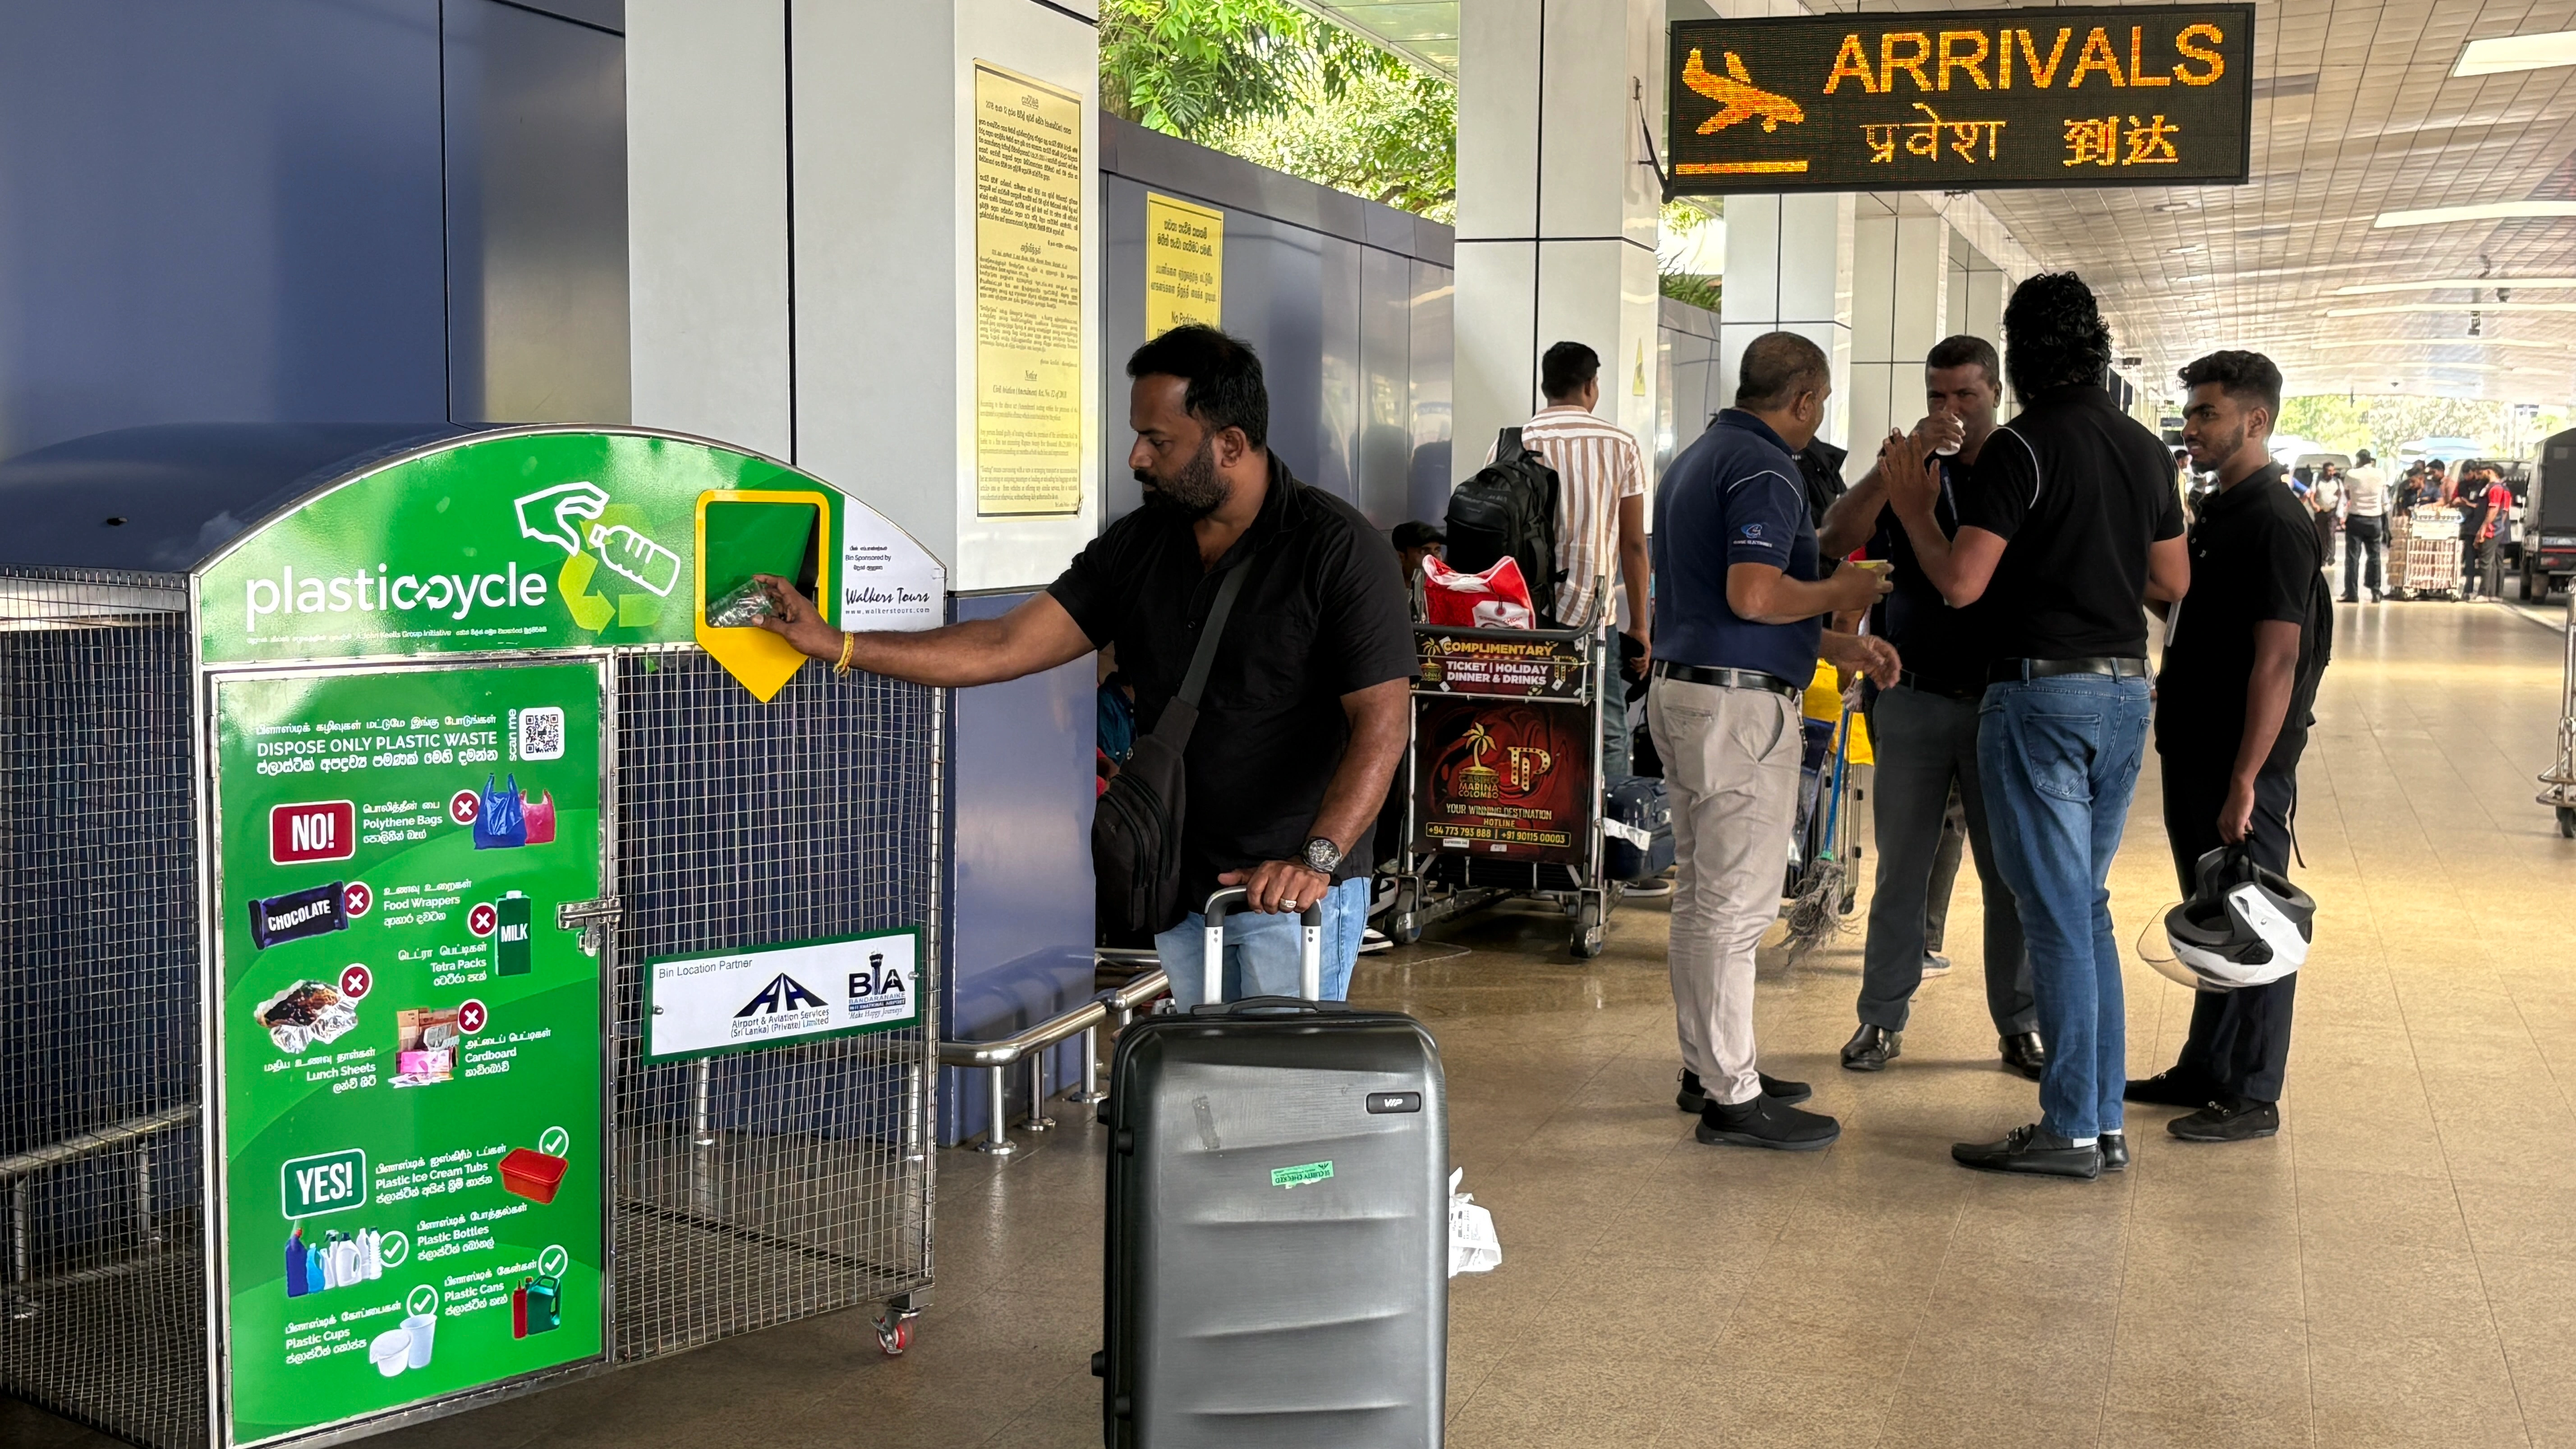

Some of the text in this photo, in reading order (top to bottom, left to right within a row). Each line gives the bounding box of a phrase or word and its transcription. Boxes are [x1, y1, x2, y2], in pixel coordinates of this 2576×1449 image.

[1824, 23, 2226, 94] ARRIVALS
[1859, 102, 2006, 163] प्रवेश
[2062, 115, 2180, 166] 到达
[1172, 310, 1178, 324] No
[846, 587, 929, 606] Walkers Tours
[380, 630, 401, 639] Keells
[402, 630, 422, 639] Group
[1443, 640, 1555, 656] COMPLIMENTARY
[1446, 661, 1548, 675] TICKET HOLIDAY
[1447, 672, 1490, 683] DINNER
[1492, 673, 1500, 683] &
[1502, 674, 1547, 685] DRINKS
[316, 720, 362, 735] கழிவுகள்
[366, 718, 405, 731] மட்டுமே
[410, 716, 440, 730] இங்கு
[444, 714, 497, 727] போடுங்கள்
[257, 731, 498, 757] DISPOSE ONLY PLASTIC WASTE
[508, 708, 517, 762] scan me
[373, 750, 419, 768] පමණක්
[424, 749, 453, 764] මෙහි
[458, 747, 498, 766] දමන්න
[1458, 772, 1499, 784] CASINO
[1458, 782, 1499, 792] MARINA
[1458, 789, 1499, 799] COLOMBO
[422, 801, 440, 810] பை
[1446, 803, 1552, 820] YOUR WINNING DESTINATION
[292, 813, 335, 851] NO!
[363, 815, 443, 831] Polythene Bags
[1483, 818, 1515, 828] HOTLINE
[1429, 826, 1444, 834] +94
[1445, 826, 1459, 836] 773
[1460, 828, 1474, 837] 793
[1476, 830, 1491, 838] 888
[1516, 832, 1538, 841] 90115
[1540, 834, 1565, 843] 00003
[383, 878, 472, 895] உணவு உறைகள்
[384, 896, 460, 911] Food Wrappers
[268, 899, 331, 932] CHOCOLATE
[501, 923, 528, 943] MILK
[398, 941, 488, 961] டெட்ரா பெட்டிகள்
[430, 957, 487, 972] Tetra Packs
[659, 958, 753, 979] Bin Location Partner
[848, 992, 906, 1004] BANDARANAIKE
[732, 1009, 829, 1029] Airport & Aviation Services
[745, 1025, 769, 1035] Lanka)
[771, 1021, 800, 1033] (Private)
[803, 1016, 829, 1028] Limited
[465, 1027, 551, 1050] அட்டைப் பெட்டிகள்
[294, 1055, 332, 1067] உணவு
[337, 1046, 376, 1063] தாள்கள்
[465, 1046, 517, 1063] Cardboard
[306, 1062, 376, 1081] Lunch Sheets
[1384, 1098, 1403, 1108] VIP
[296, 1162, 353, 1205] YES!
[376, 1162, 488, 1190] Plastic Ice Cream Tubs
[470, 1202, 528, 1221] போத்தல்கள்
[418, 1225, 489, 1247] Plastic Bottles
[444, 1282, 505, 1302] Plastic Cans
[286, 1329, 350, 1350] Plastic Cups
